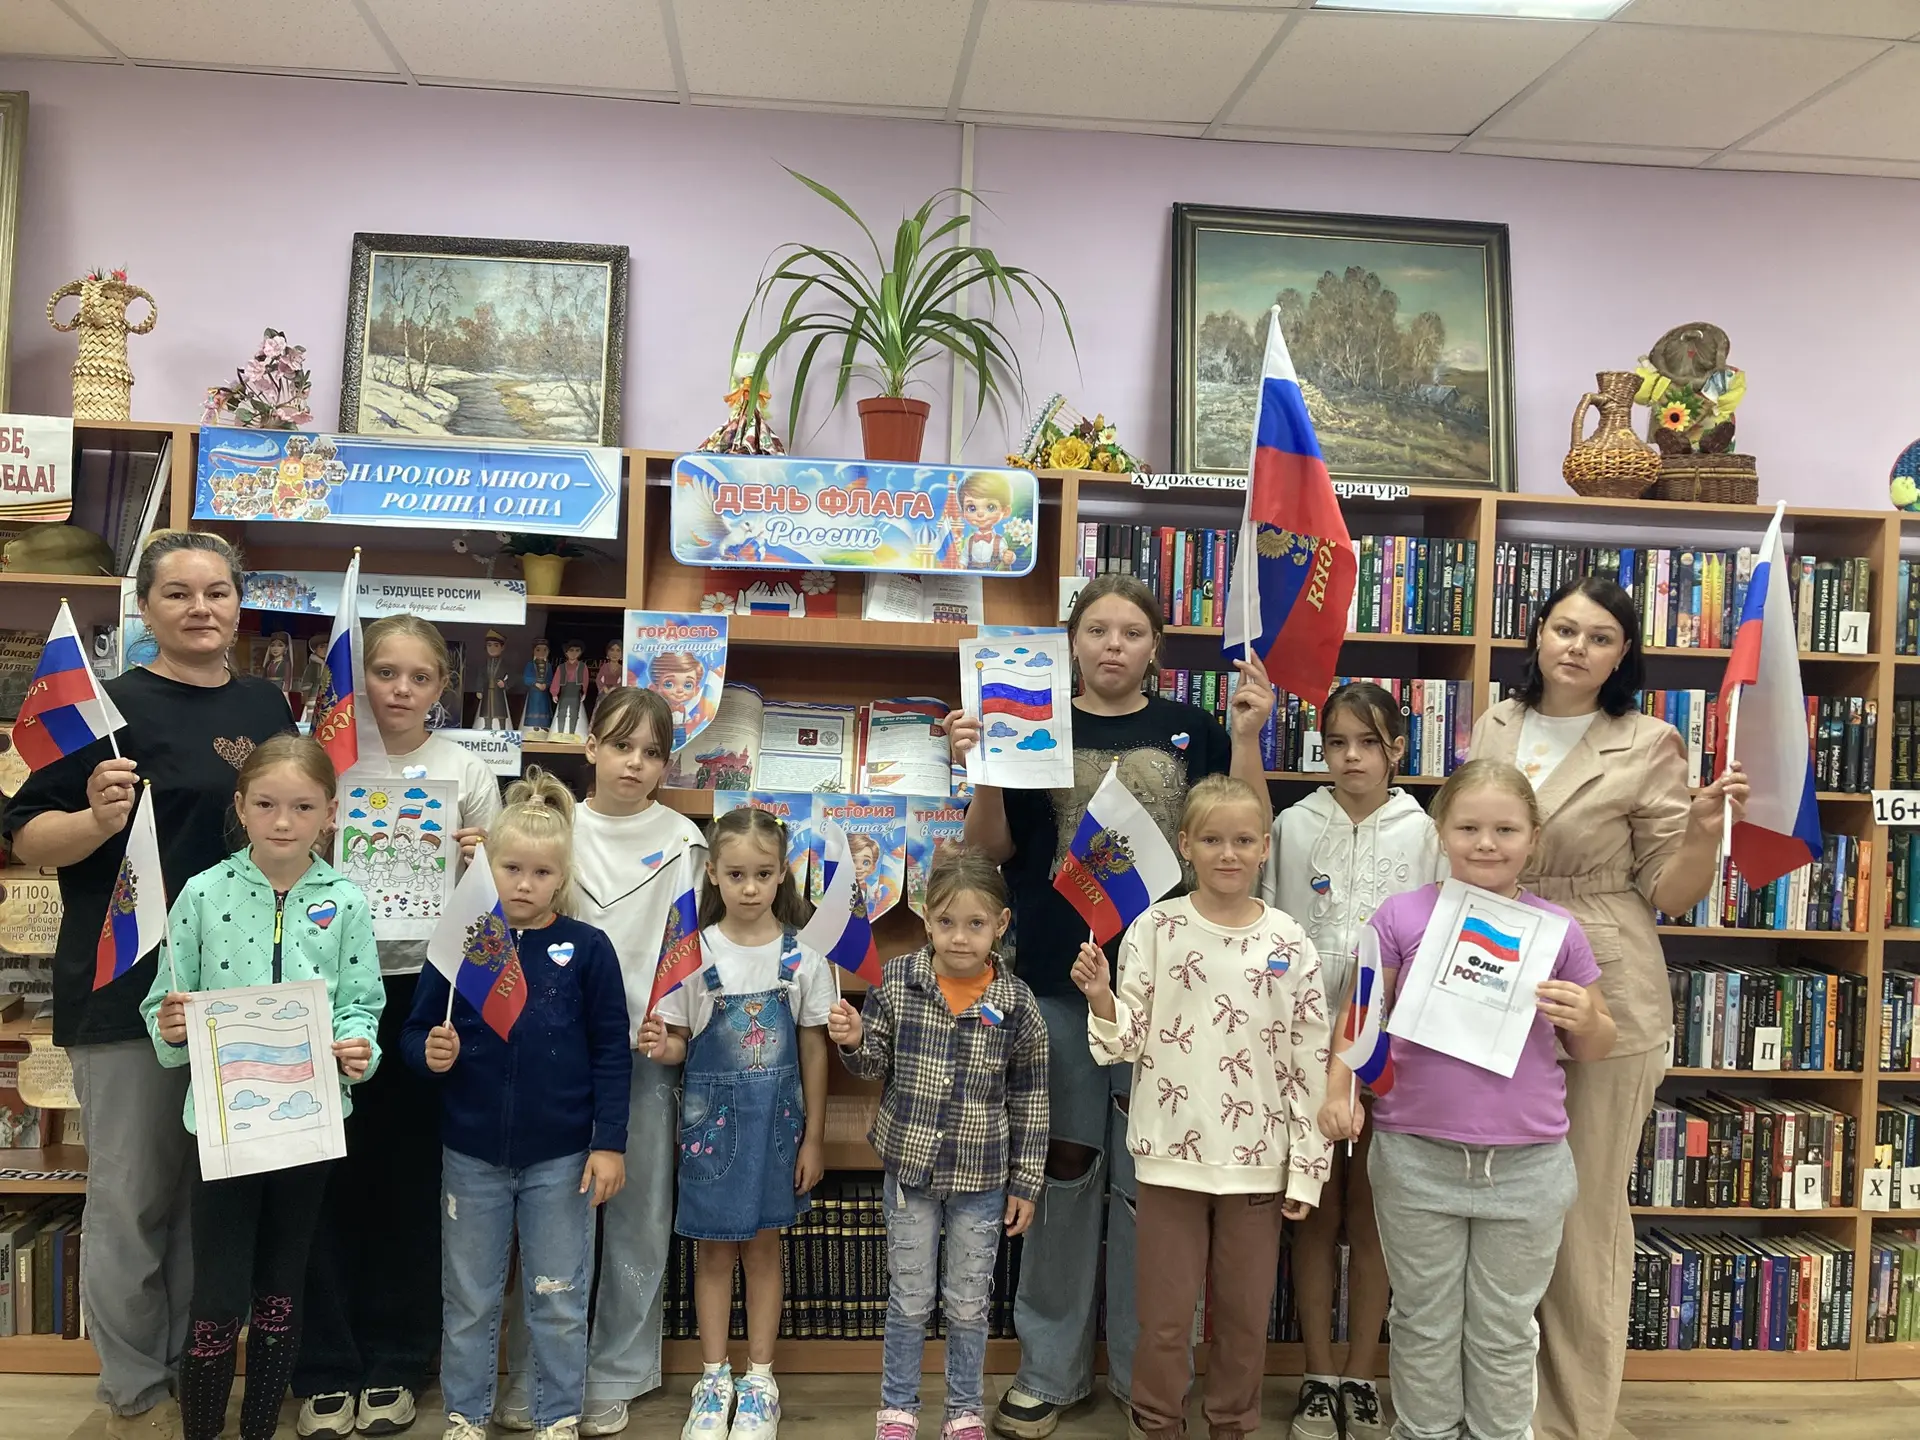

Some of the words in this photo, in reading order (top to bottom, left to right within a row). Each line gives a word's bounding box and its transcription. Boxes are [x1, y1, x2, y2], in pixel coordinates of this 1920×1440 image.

[0, 427, 30, 459] БЕ,
[0, 464, 56, 494] ЕДА!
[348, 462, 472, 487] НАРОДОВ
[475, 469, 570, 491] МНОГО
[1134, 474, 1247, 489] Художестве
[1335, 482, 1409, 499] ература
[381, 491, 486, 514] РОДИНА
[492, 496, 563, 517] ОДНА
[712, 484, 811, 514] ДЕНЬ
[817, 487, 935, 518] ФЛАГА
[766, 517, 882, 549] России
[383, 585, 434, 601] БУДУЩЕЕ
[438, 588, 481, 602] РОССИИ
[1820, 579, 1829, 608] Кураев
[635, 624, 719, 640] ГОРДОСТЬ
[1453, 617, 1461, 632] СВЕТ
[1819, 610, 1827, 639] Михаил
[1842, 625, 1858, 642] Л
[632, 642, 643, 653] и
[645, 641, 722, 656] традиции
[1310, 745, 1324, 762] В
[822, 805, 895, 818] ИСТОРИЯ
[914, 809, 965, 823] ТРИКО
[1876, 797, 1920, 821] 16+
[932, 828, 964, 842] серд
[1061, 858, 1104, 906] ОССИЯ
[12, 886, 20, 899] И
[27, 886, 53, 900] 100,
[28, 904, 36, 914] и
[12, 933, 24, 941] не
[29, 932, 57, 941] смож
[1468, 955, 1504, 974] Флаг
[1761, 1042, 1775, 1060] П
[0, 1168, 87, 1181] ВОЙН
[1804, 1178, 1815, 1194] Р
[1870, 1179, 1884, 1196] Х
[1712, 1290, 1720, 1305] ЮГА
[1711, 1307, 1719, 1328] ЗАКОН
[1661, 1307, 1669, 1347] СПЕЦНАЗ
